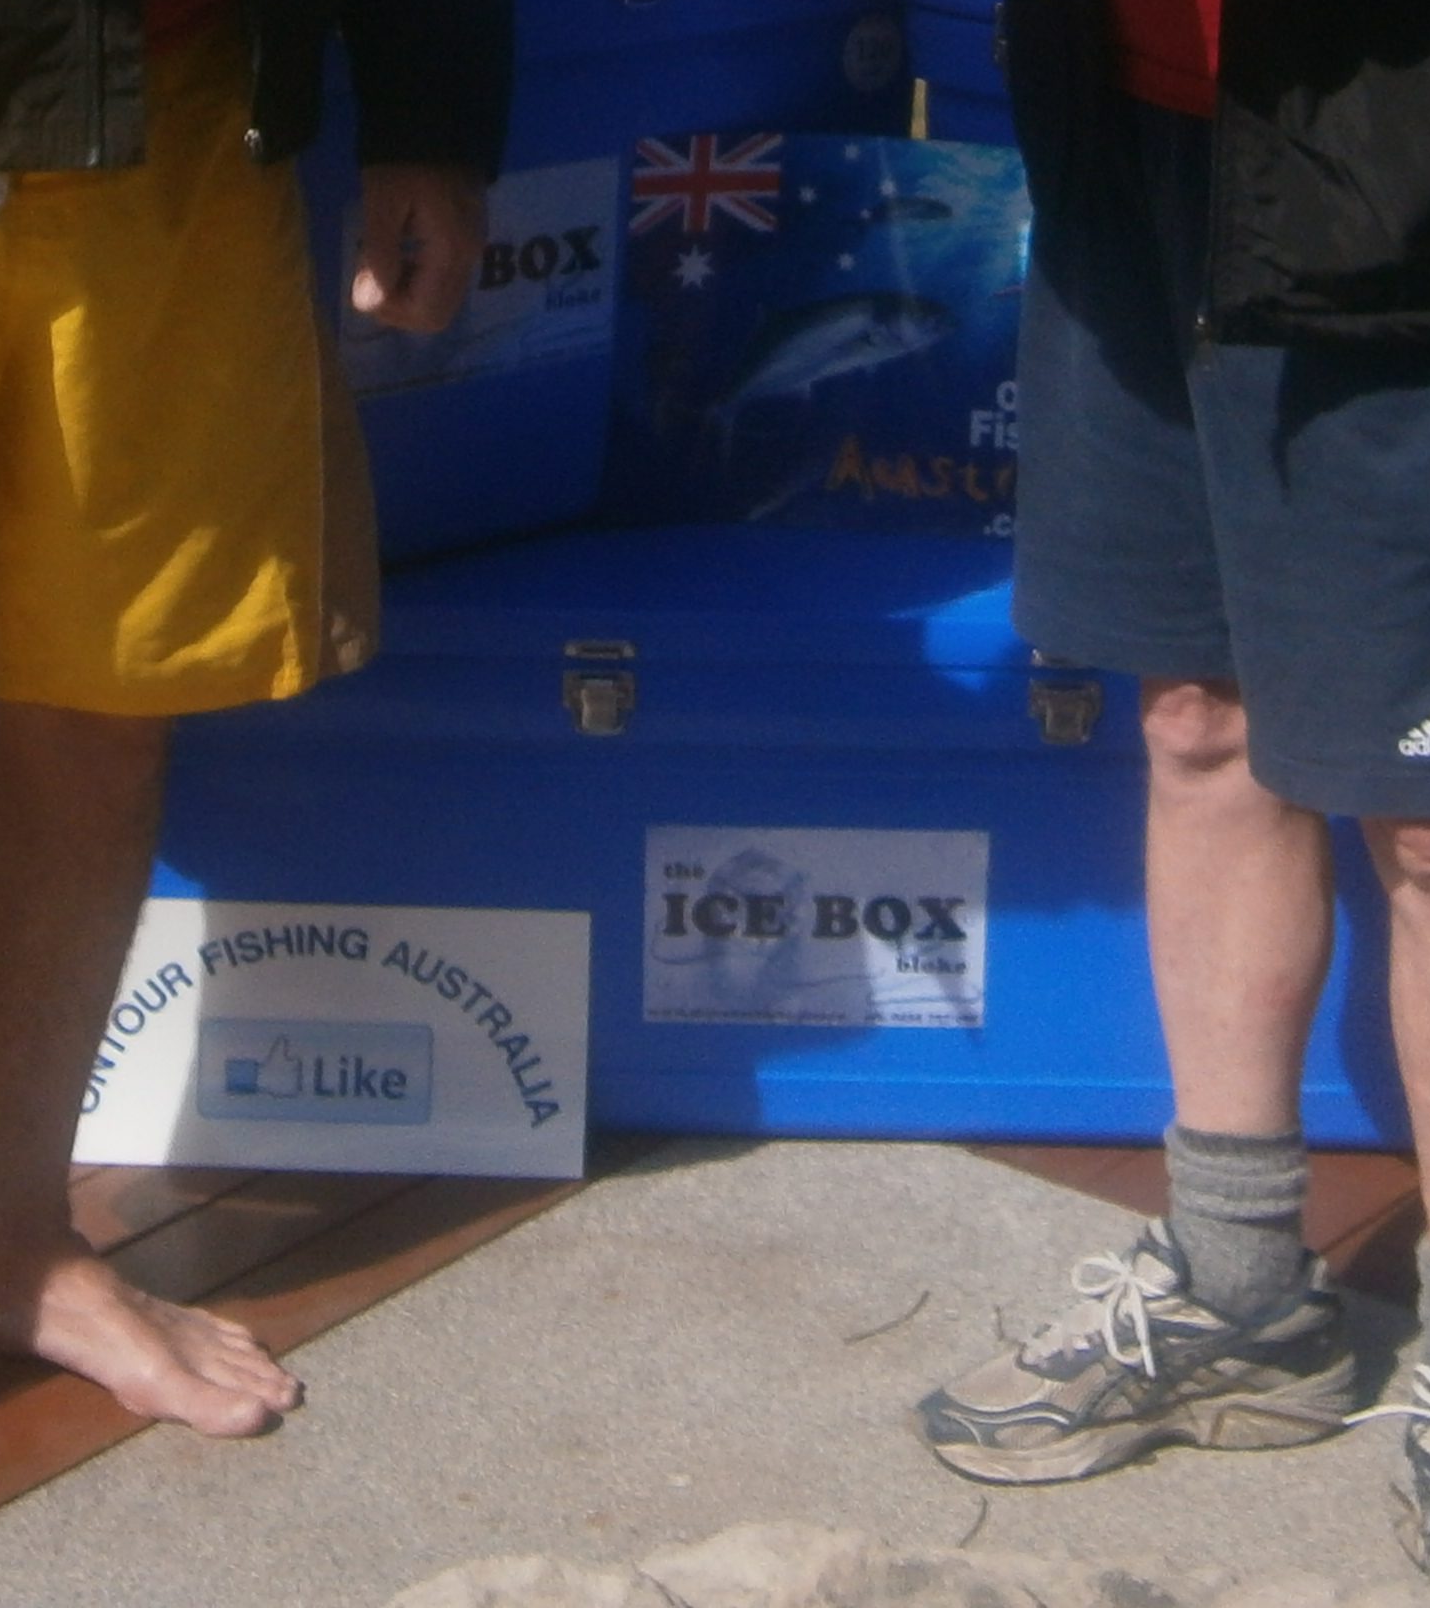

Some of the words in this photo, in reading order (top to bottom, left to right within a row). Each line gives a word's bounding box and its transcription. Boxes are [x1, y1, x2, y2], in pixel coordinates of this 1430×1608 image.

[478, 225, 601, 291] BOX
[969, 409, 1020, 449] Fis
[663, 892, 785, 938] ICE
[811, 895, 967, 942] BOX
[198, 922, 369, 976] FISHING
[381, 939, 563, 1130] AUSTRALIA
[313, 1054, 408, 1101] Like
